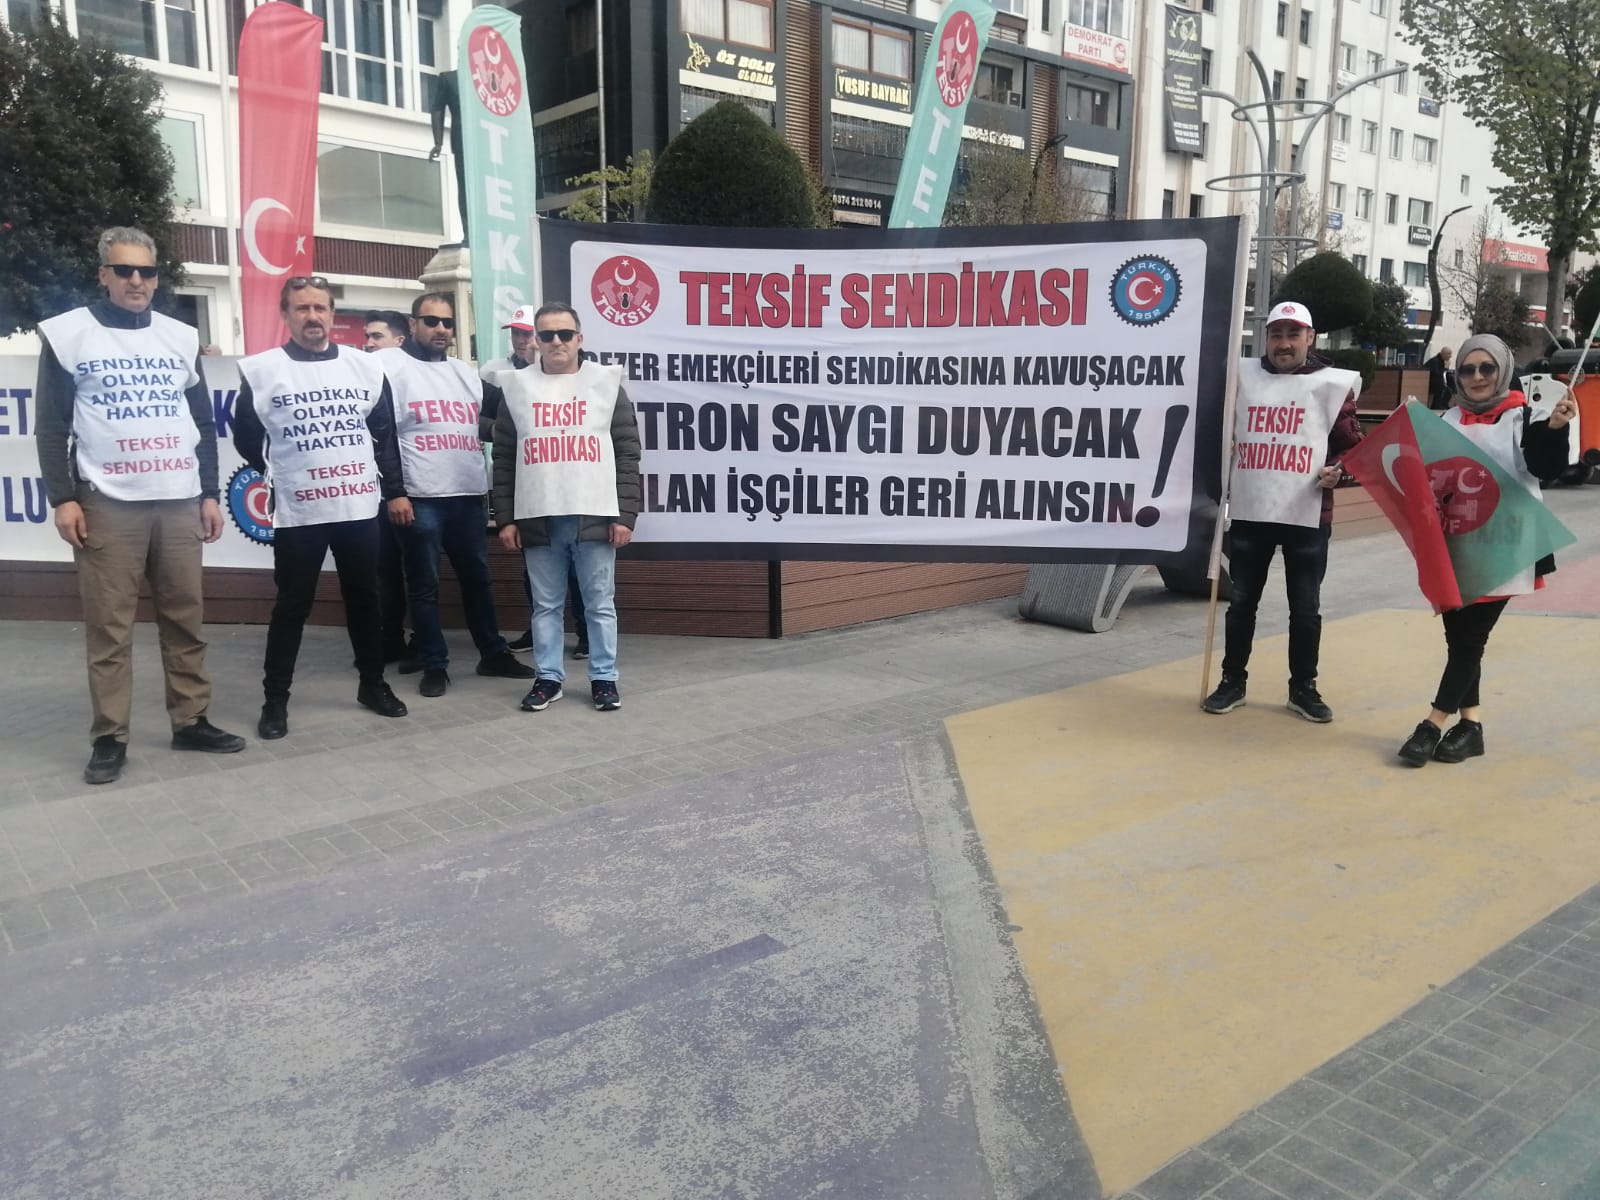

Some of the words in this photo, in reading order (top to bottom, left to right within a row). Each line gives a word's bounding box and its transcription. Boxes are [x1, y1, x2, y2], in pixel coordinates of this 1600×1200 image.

[1068, 27, 1112, 47] DEMOKRAT
[738, 56, 775, 73] BOLU
[738, 69, 774, 86] GLOBAL
[838, 76, 870, 97] YUSUF
[871, 82, 909, 105] BAYRAK
[679, 264, 831, 328] TEKSİF
[841, 262, 1089, 329] SENDİKASI
[1128, 308, 1161, 320] 1952
[667, 350, 819, 389] EMEKÇİLERİ
[827, 351, 1006, 385] SENDİKASINA
[1014, 355, 1186, 391] KAVUŞACAK
[102, 374, 175, 388] OLMAK
[92, 389, 182, 405] ANAYASA
[272, 387, 370, 408] SENDİKALI
[106, 405, 180, 420] HAKTIR
[293, 404, 360, 420] OLMAK
[532, 396, 587, 428] TEKSİF
[1247, 401, 1305, 434] TEKSİF
[283, 419, 365, 438] ANAYASAL
[632, 401, 758, 452] TRON
[772, 403, 905, 455] SAYGI
[917, 406, 1142, 459] DUYACAK
[115, 434, 180, 452] TEKSİF
[296, 434, 365, 452] HAKTIR
[524, 430, 601, 465] SENDİKASI
[1238, 437, 1313, 474] SENDİKASI
[307, 461, 366, 480] TEKSİF
[727, 467, 869, 522] İŞÇİLER
[880, 471, 966, 518] GERİ
[975, 479, 1135, 523] ALINSIN
